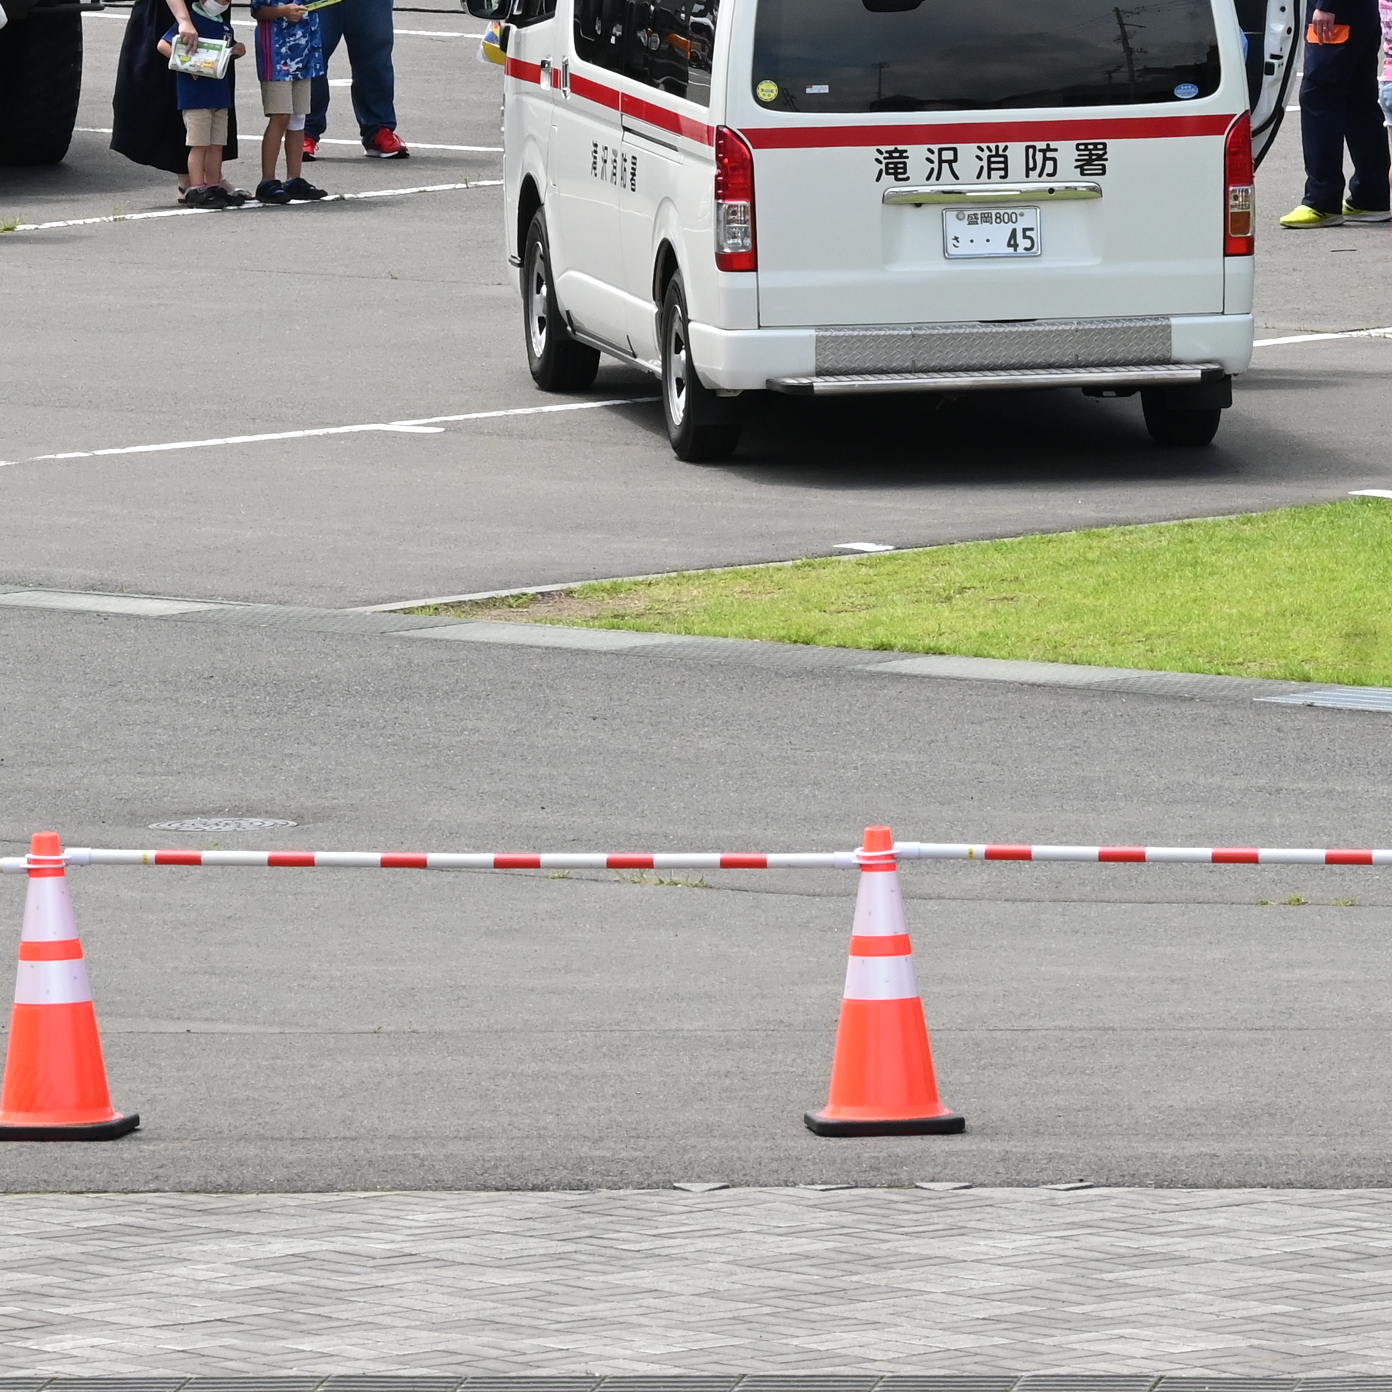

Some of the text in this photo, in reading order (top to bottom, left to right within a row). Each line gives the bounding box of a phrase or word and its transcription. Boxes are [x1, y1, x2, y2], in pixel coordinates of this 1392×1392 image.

[591, 140, 638, 193] 滝沢消防署
[874, 142, 1109, 183] 滝沢消防署
[967, 212, 1018, 226] 盛岡800
[1006, 228, 1035, 252] 45
